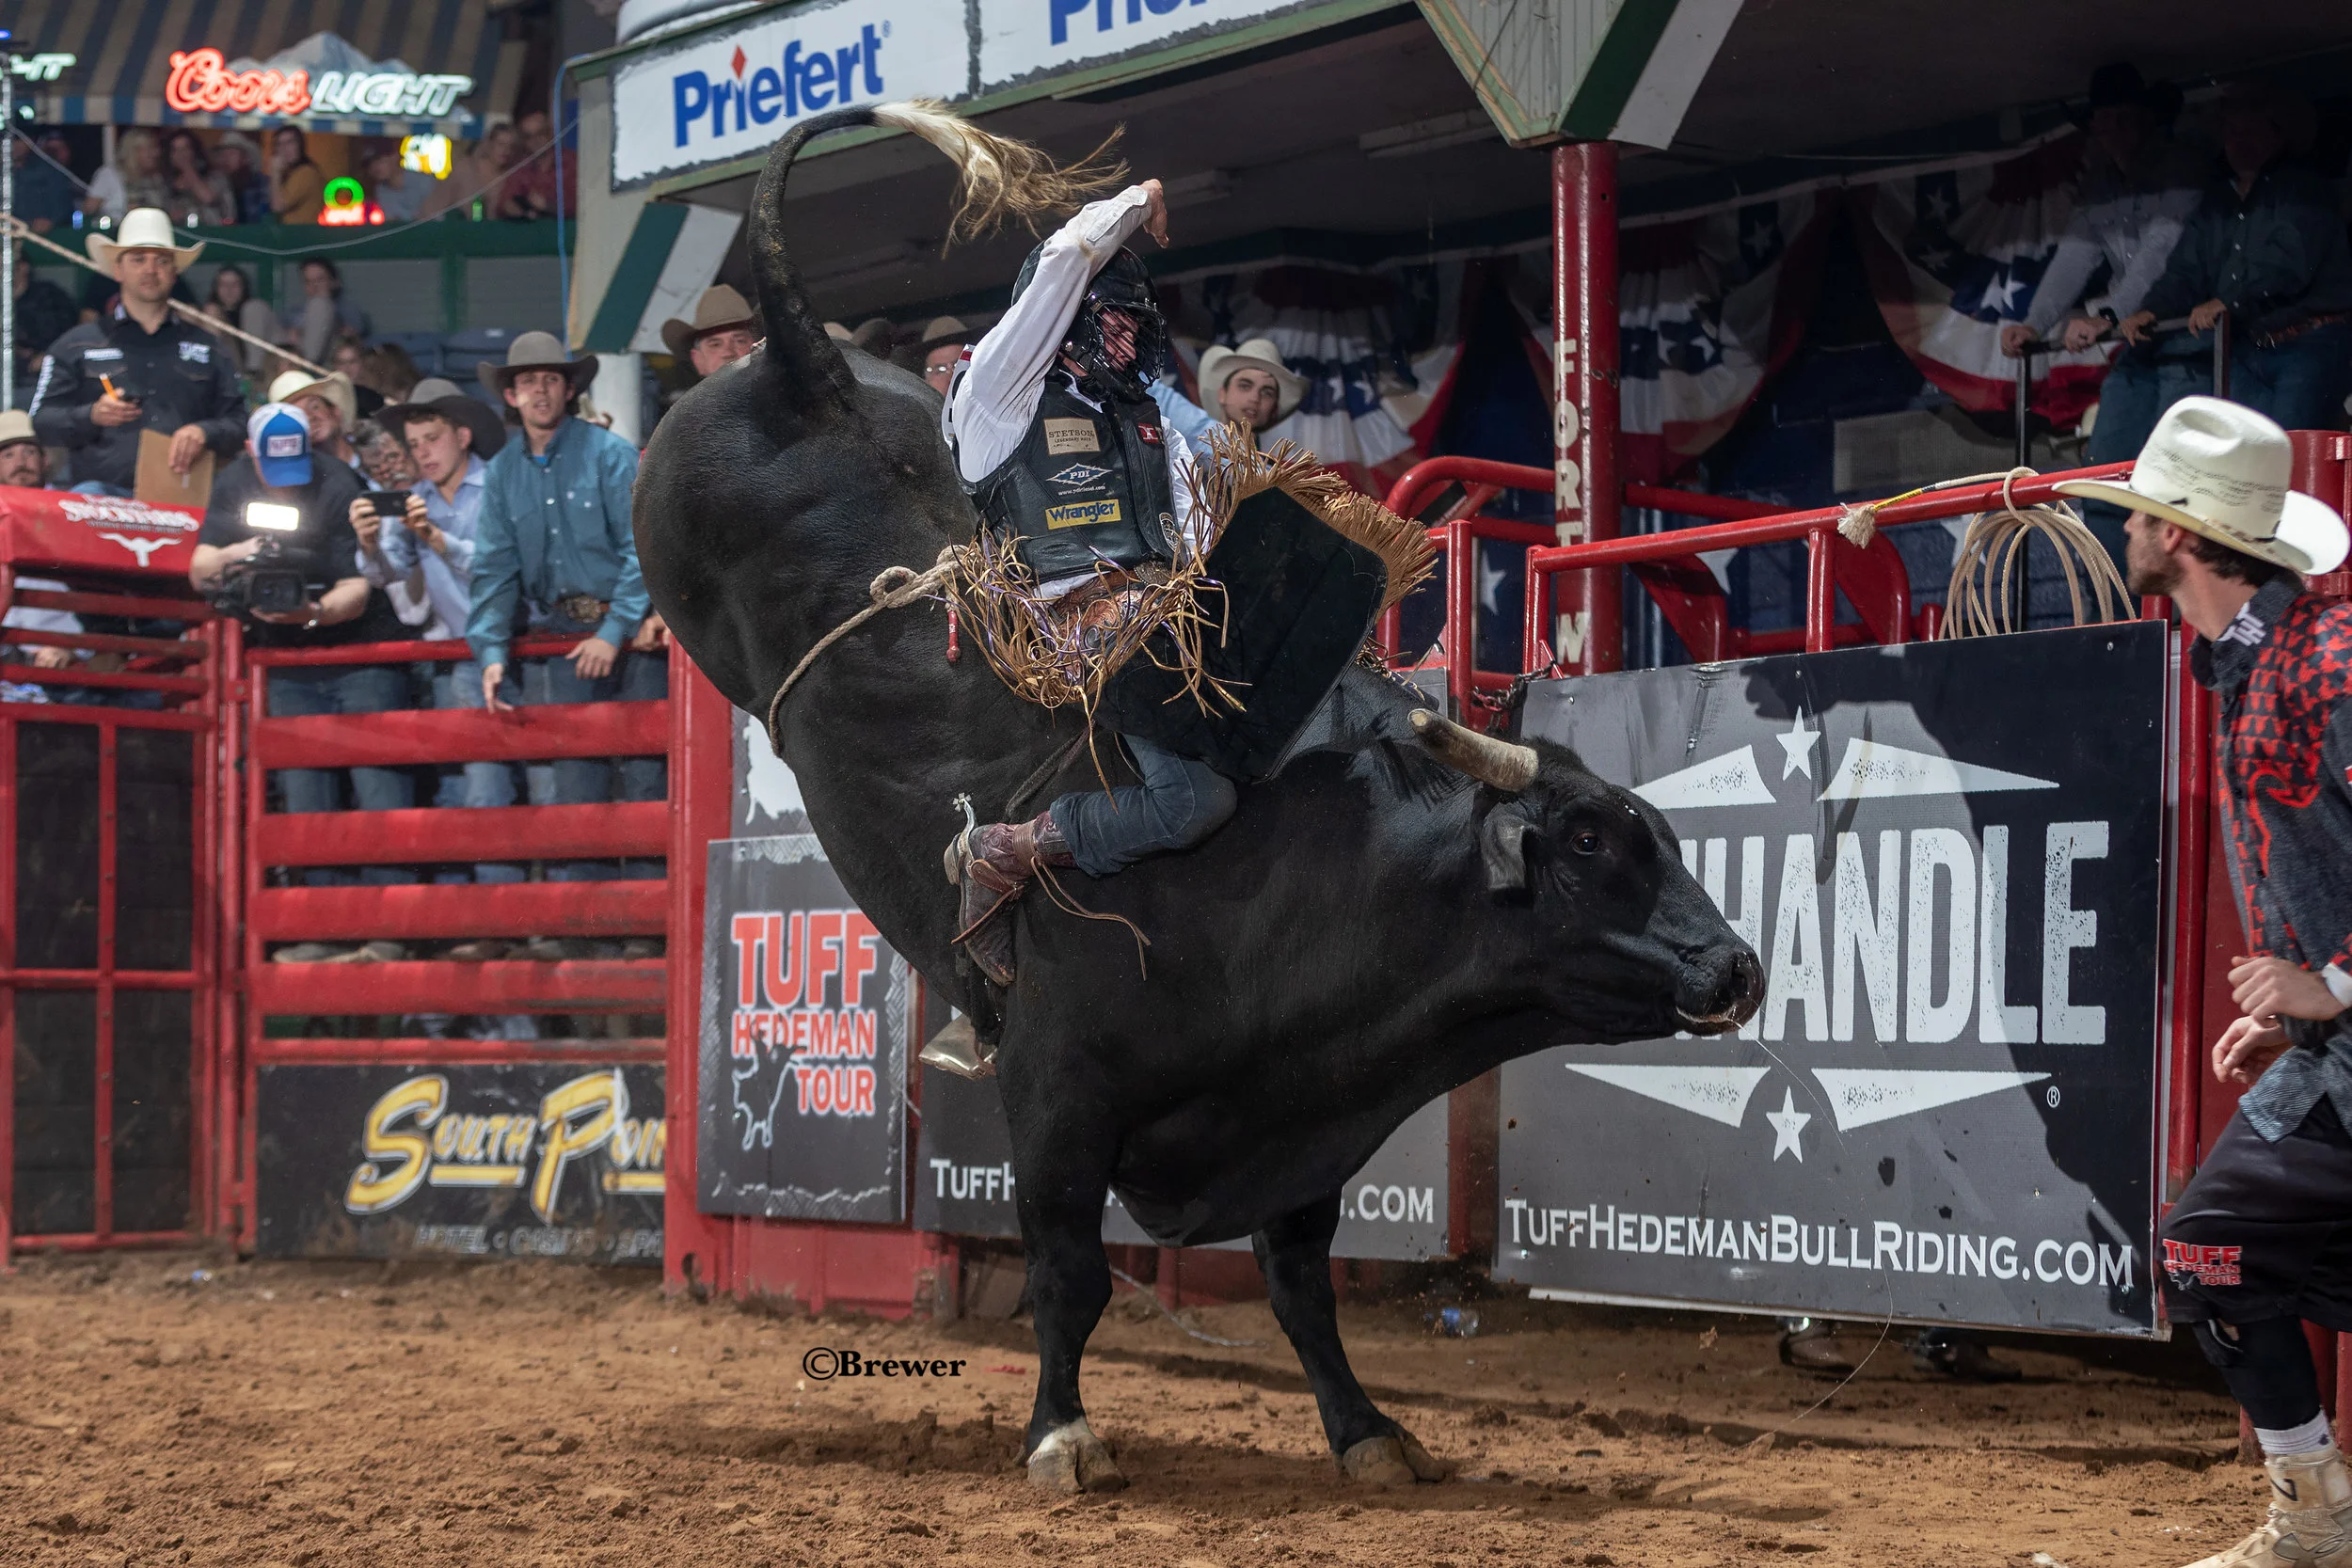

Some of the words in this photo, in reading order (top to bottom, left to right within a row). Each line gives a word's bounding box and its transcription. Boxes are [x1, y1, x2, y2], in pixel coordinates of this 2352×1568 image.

[166, 47, 311, 115] Coors
[310, 71, 472, 117] LIGHT
[673, 24, 884, 148] Priefert
[1048, 429, 1094, 438] STETSON
[1070, 470, 1090, 480] PDI
[1049, 502, 1116, 522] Wrangler
[1678, 820, 2109, 1045] HANDLE
[732, 909, 882, 1008] TUFF
[731, 1009, 877, 1060] HEDEMAN
[796, 1065, 877, 1117] TOUR
[2163, 1238, 2243, 1265] TUFF
[2199, 1275, 2242, 1286] TOUR
